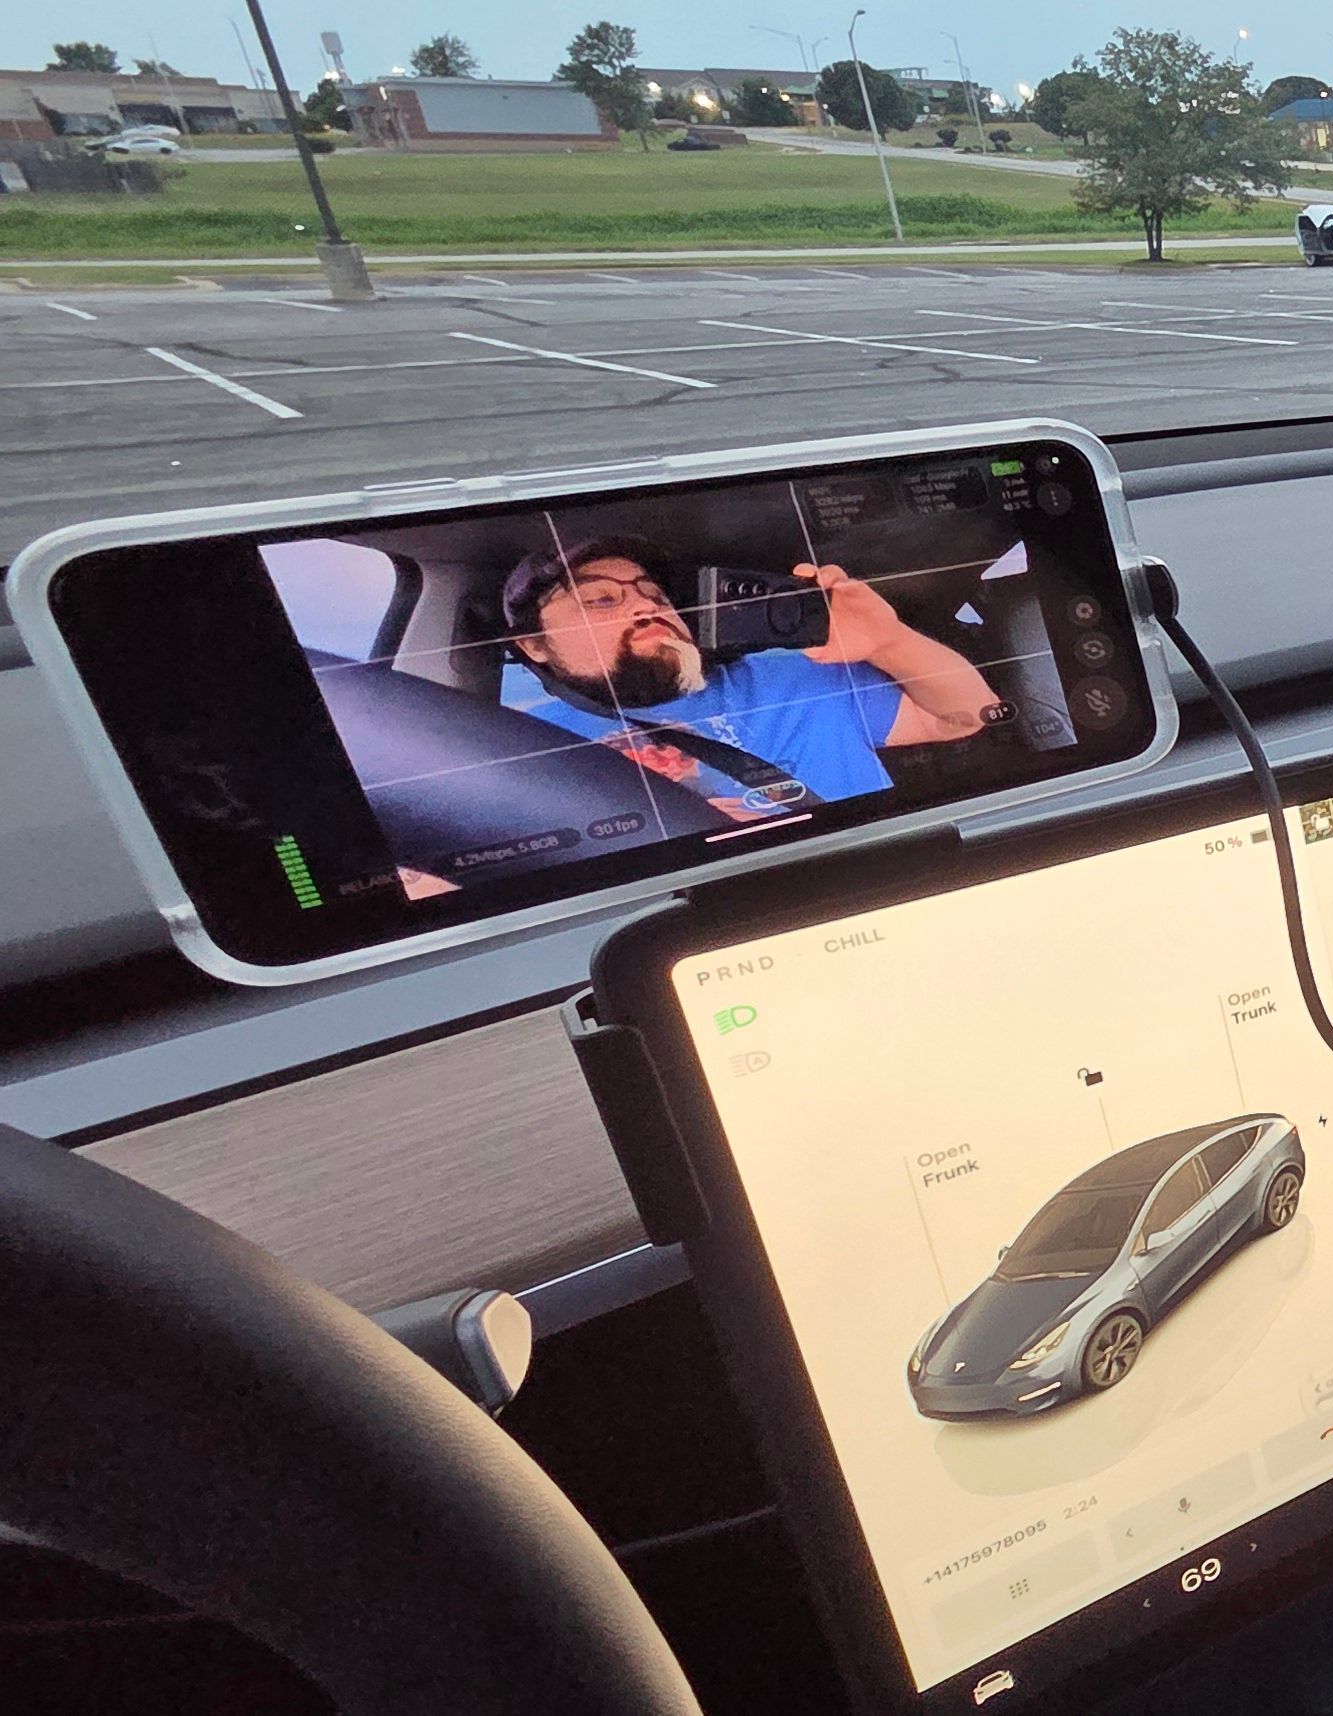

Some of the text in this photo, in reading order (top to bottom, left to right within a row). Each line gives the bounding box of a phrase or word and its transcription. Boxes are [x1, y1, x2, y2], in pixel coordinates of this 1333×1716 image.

[988, 705, 1008, 721] 81°
[593, 818, 640, 837] 30 fps
[518, 835, 559, 853] 5.8GB
[824, 928, 887, 954] CHILL
[697, 955, 775, 987] P R N D
[1227, 984, 1272, 1010] Open
[1231, 1000, 1278, 1026] Trunk
[917, 1141, 972, 1168] Open
[922, 1158, 980, 1188] Frunk
[923, 1495, 1099, 1586] +14175978095 2:24
[1180, 1557, 1222, 1593] 69
